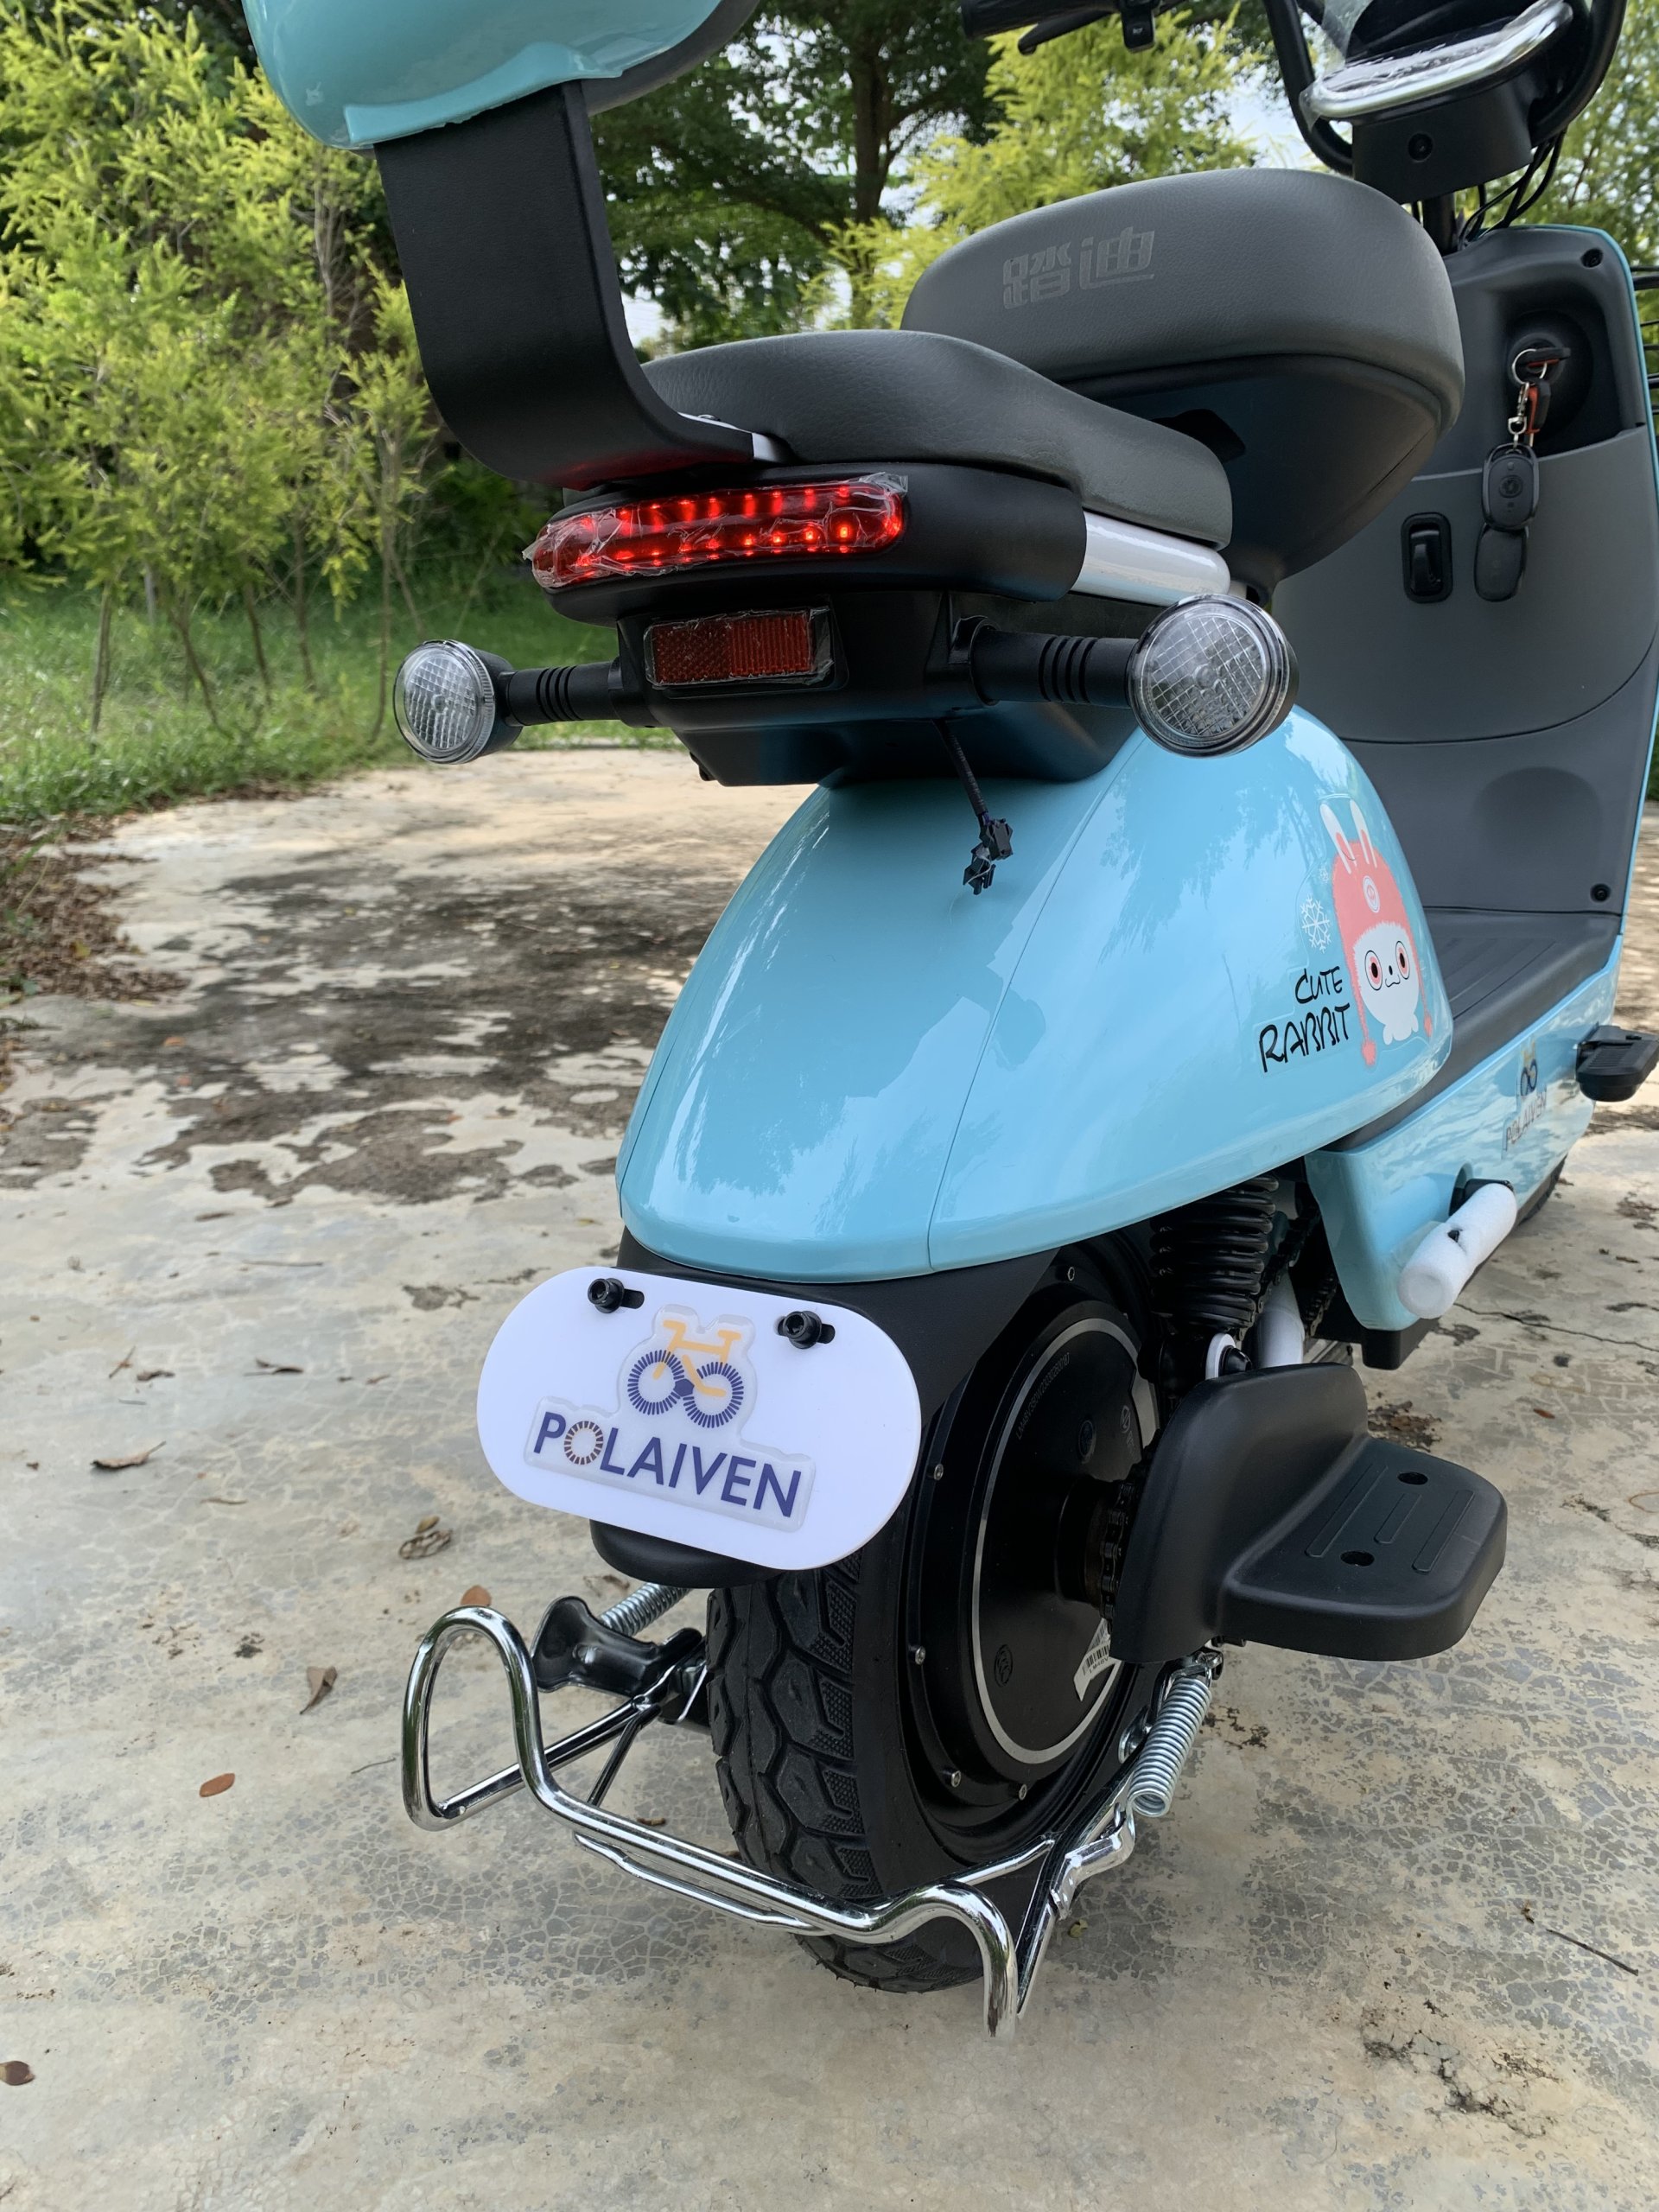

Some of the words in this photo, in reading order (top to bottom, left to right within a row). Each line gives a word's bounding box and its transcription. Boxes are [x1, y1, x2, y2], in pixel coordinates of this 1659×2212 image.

[1294, 966, 1344, 1005] CUTE
[1258, 1002, 1351, 1073] RABBIT
[532, 1411, 803, 1518] POLAIVEN
